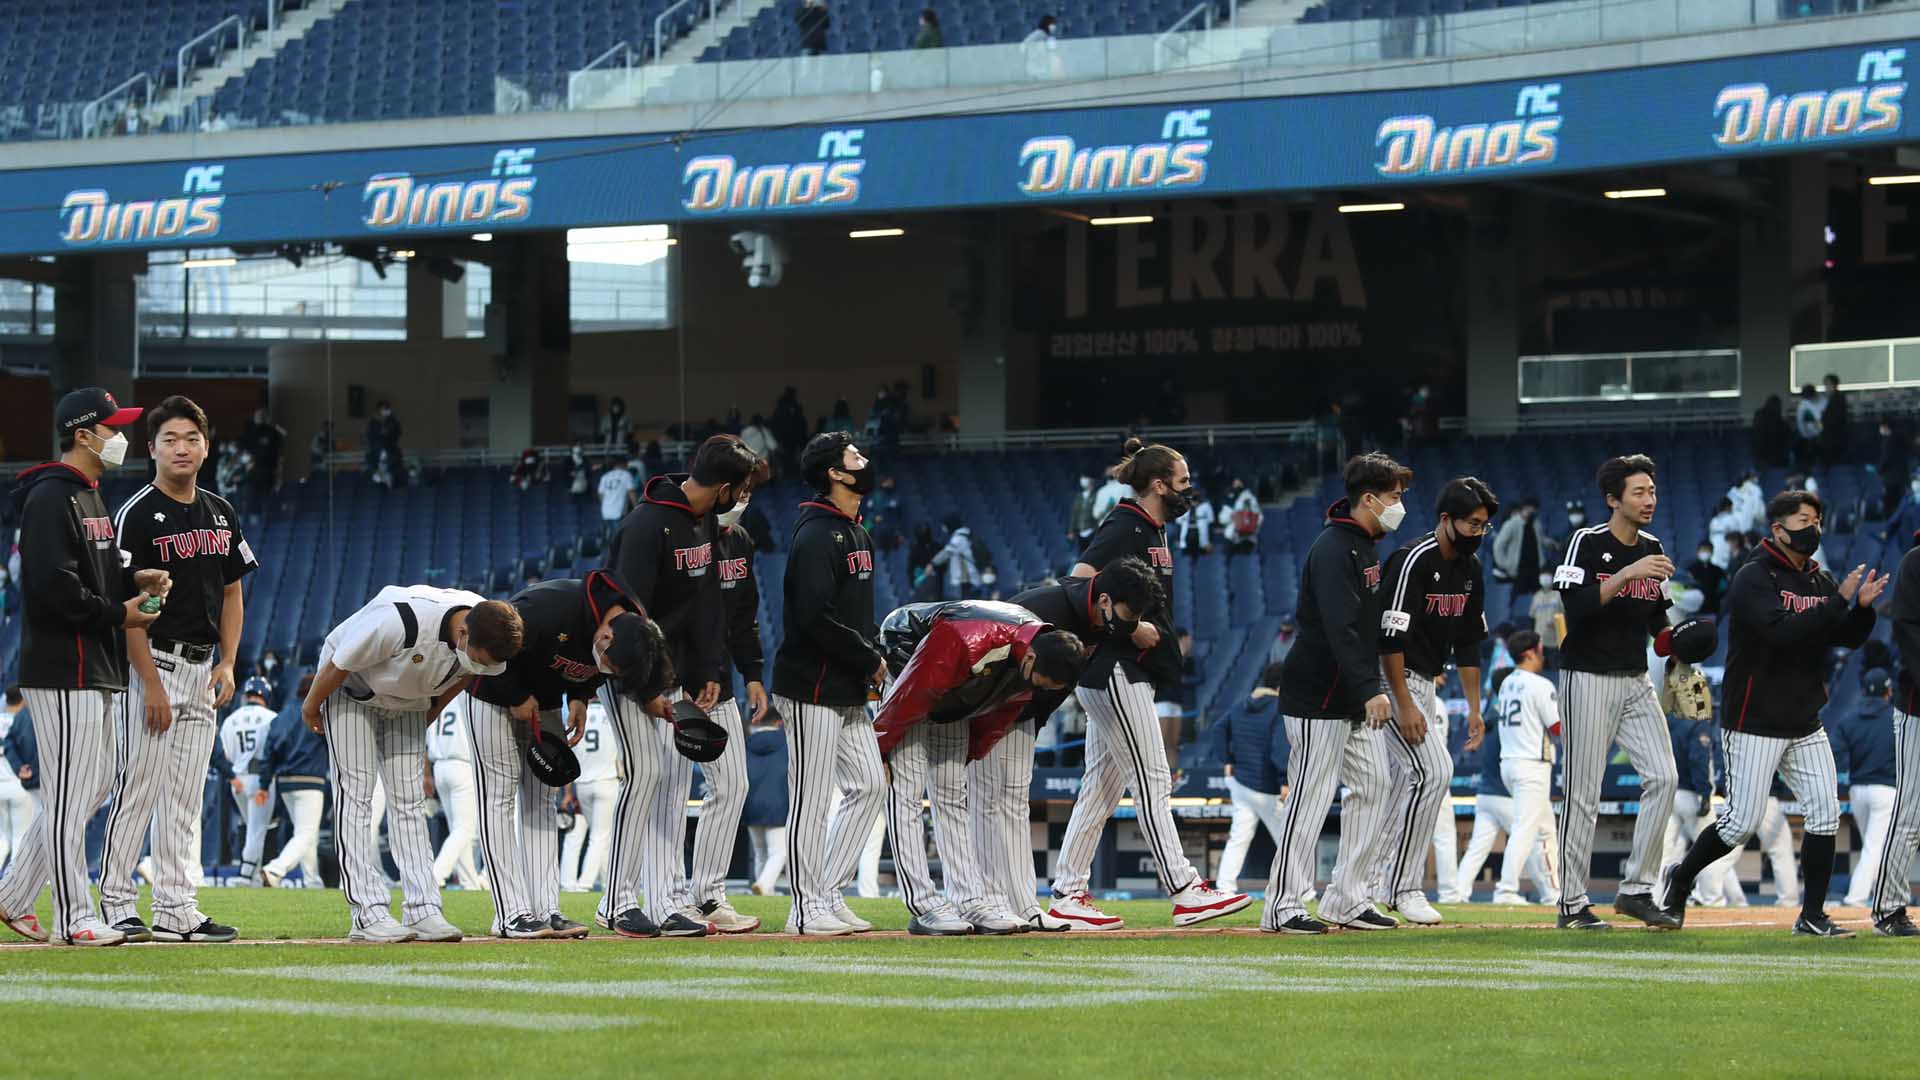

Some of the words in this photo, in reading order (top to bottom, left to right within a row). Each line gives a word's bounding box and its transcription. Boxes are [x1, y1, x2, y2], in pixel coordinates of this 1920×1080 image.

[213, 514, 228, 526] LG
[153, 528, 232, 562] TWINS
[717, 557, 748, 581] INS
[1497, 699, 1522, 727] 42
[236, 730, 257, 753] 15
